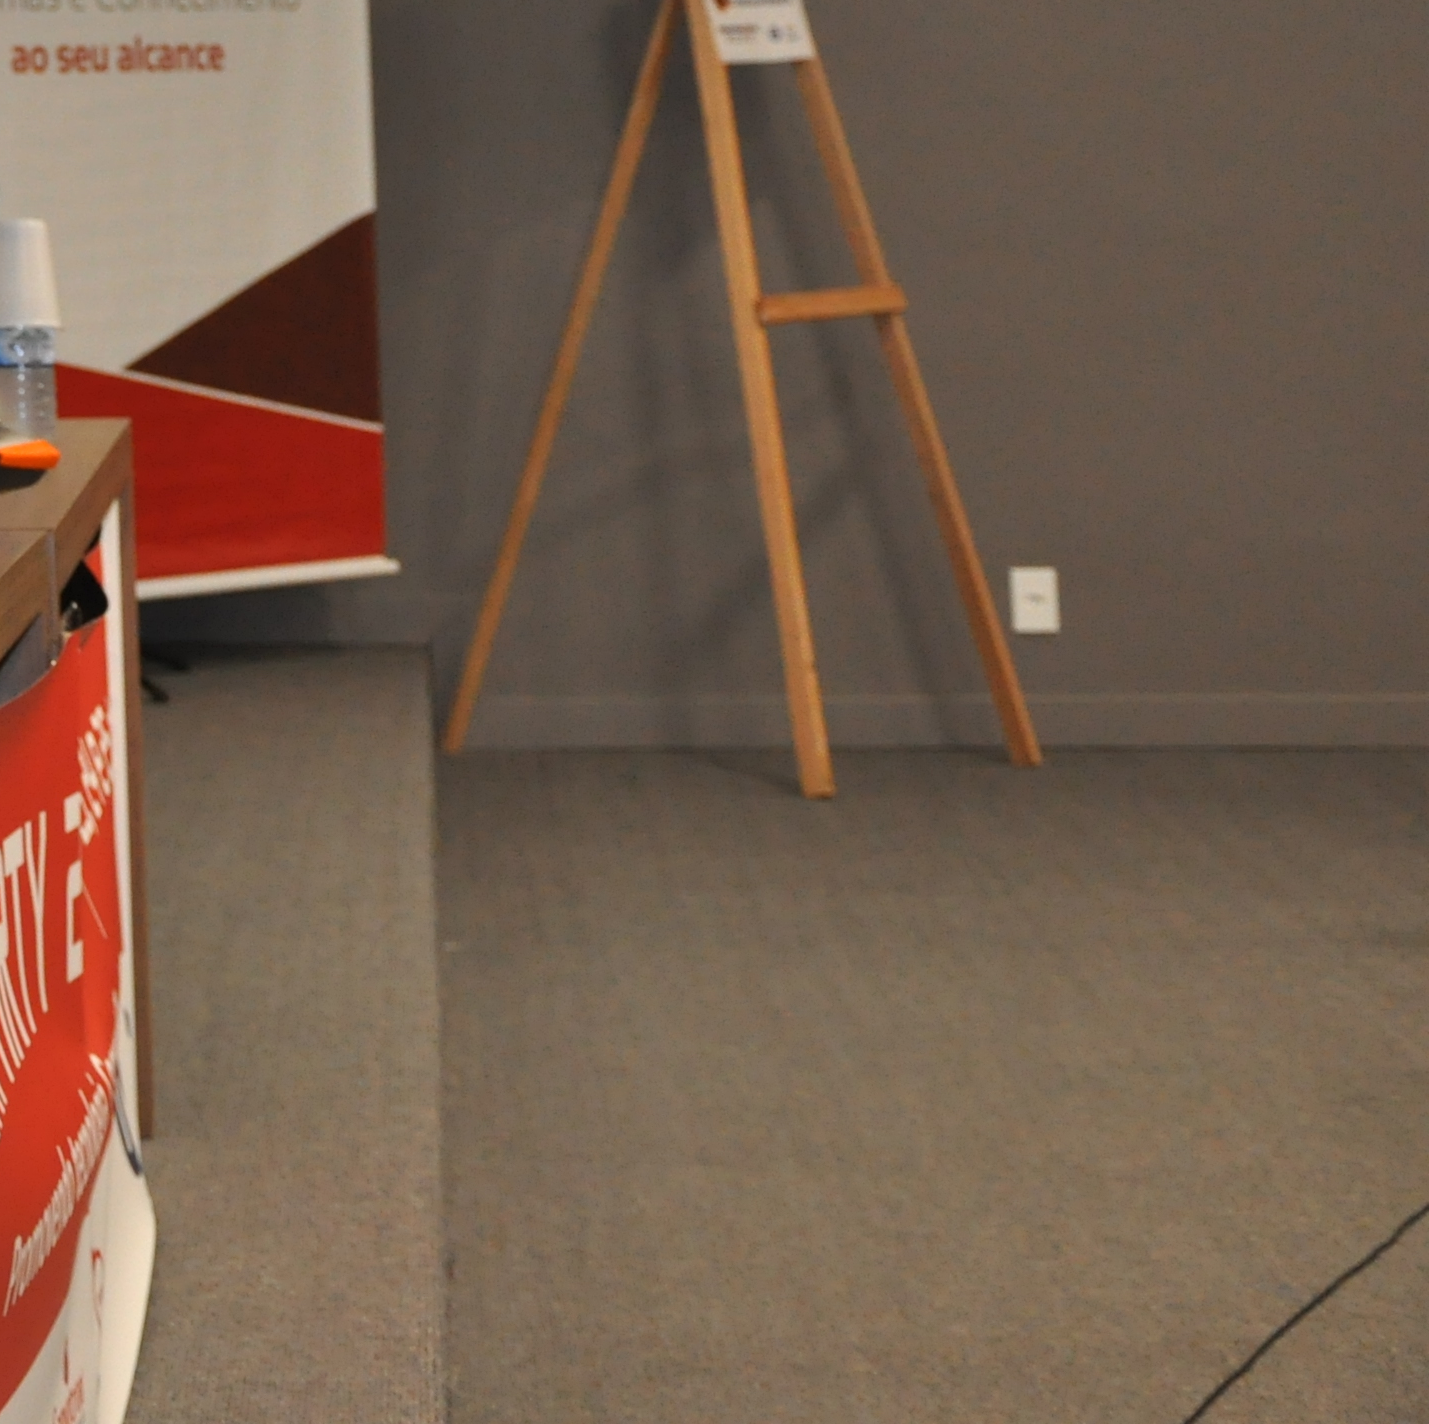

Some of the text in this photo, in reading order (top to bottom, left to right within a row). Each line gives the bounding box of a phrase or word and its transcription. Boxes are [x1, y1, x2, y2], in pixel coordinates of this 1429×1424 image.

[11, 35, 226, 73] ao seu alcance
